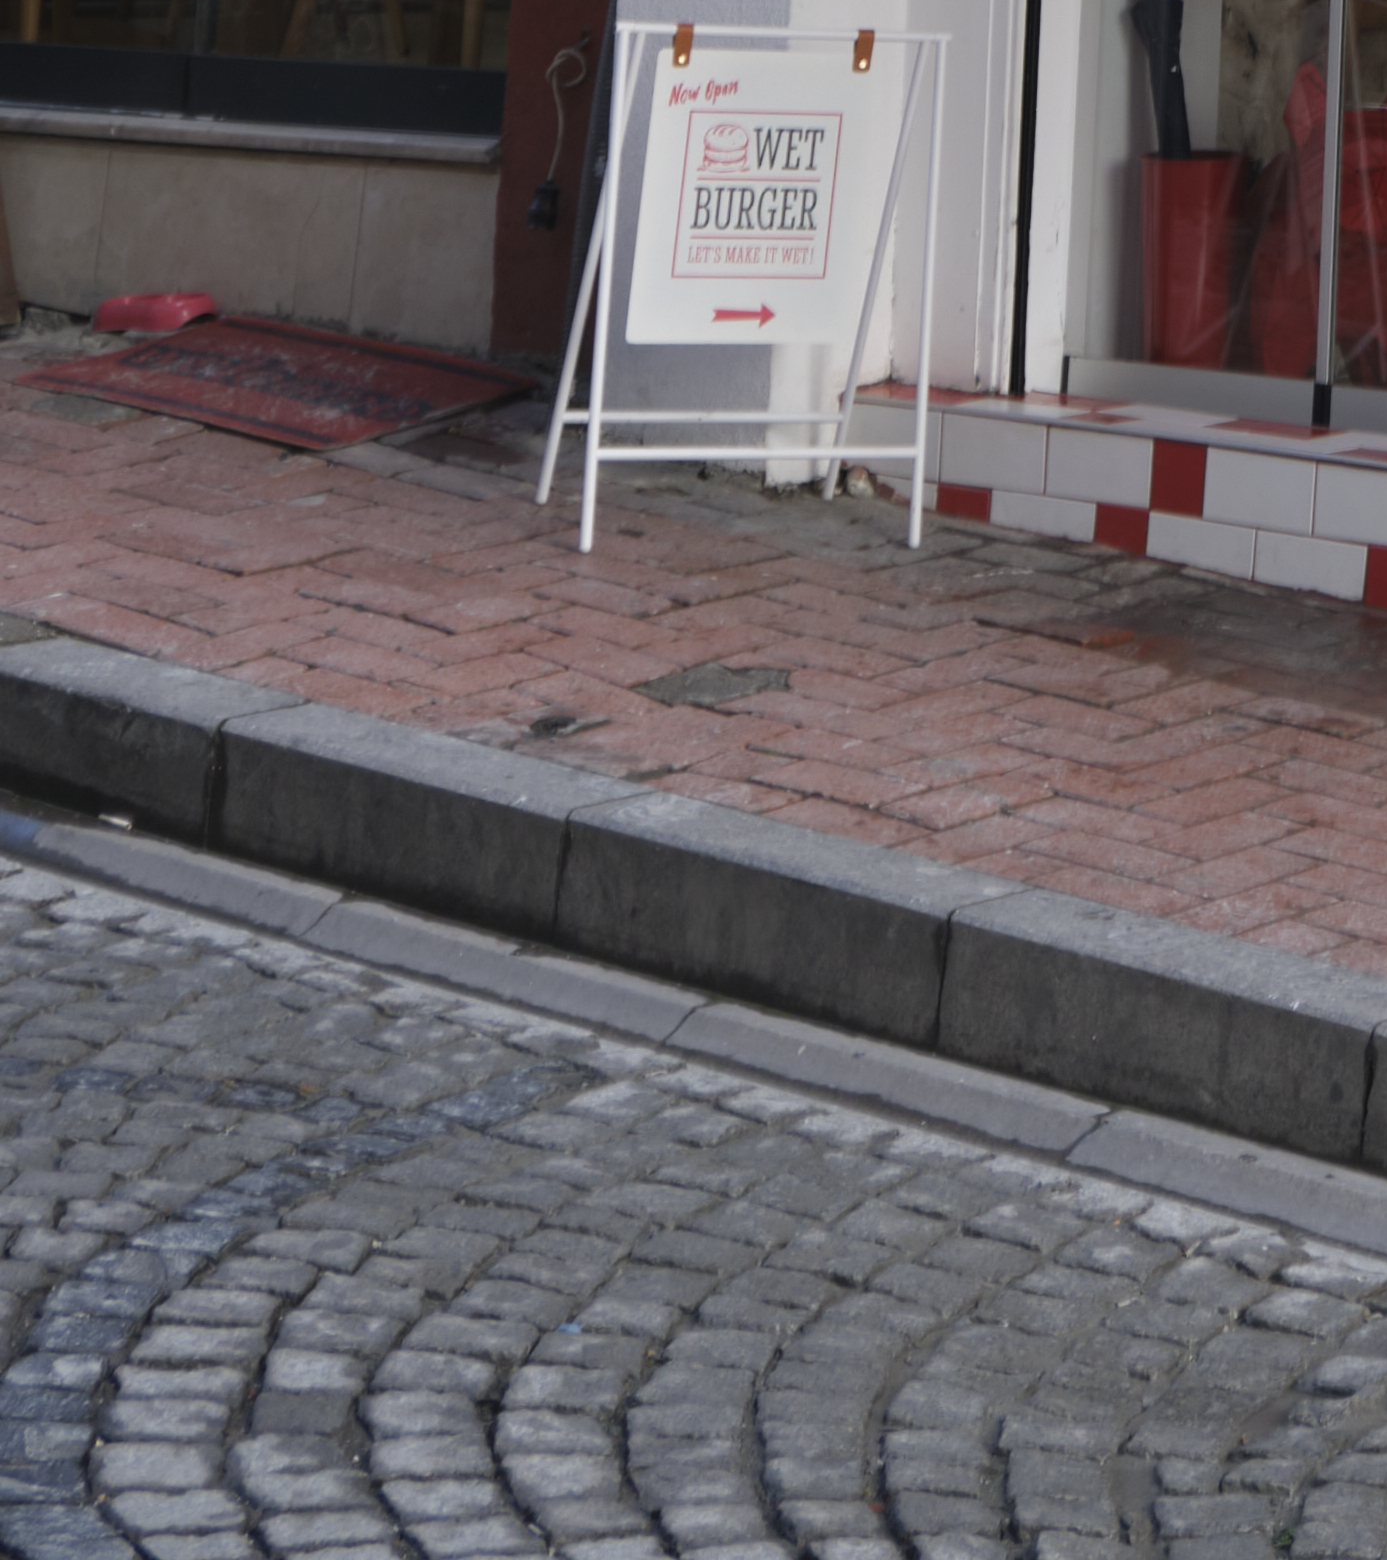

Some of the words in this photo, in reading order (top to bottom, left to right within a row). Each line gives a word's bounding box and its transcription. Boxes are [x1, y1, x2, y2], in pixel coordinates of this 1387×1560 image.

[669, 83, 700, 107] Now
[705, 77, 739, 105] Open
[754, 126, 825, 171] WET
[690, 186, 818, 231] BURGER
[687, 246, 721, 264] LET'S
[725, 246, 760, 265] MAKE
[764, 246, 778, 265] IT
[782, 247, 814, 265] WET!
